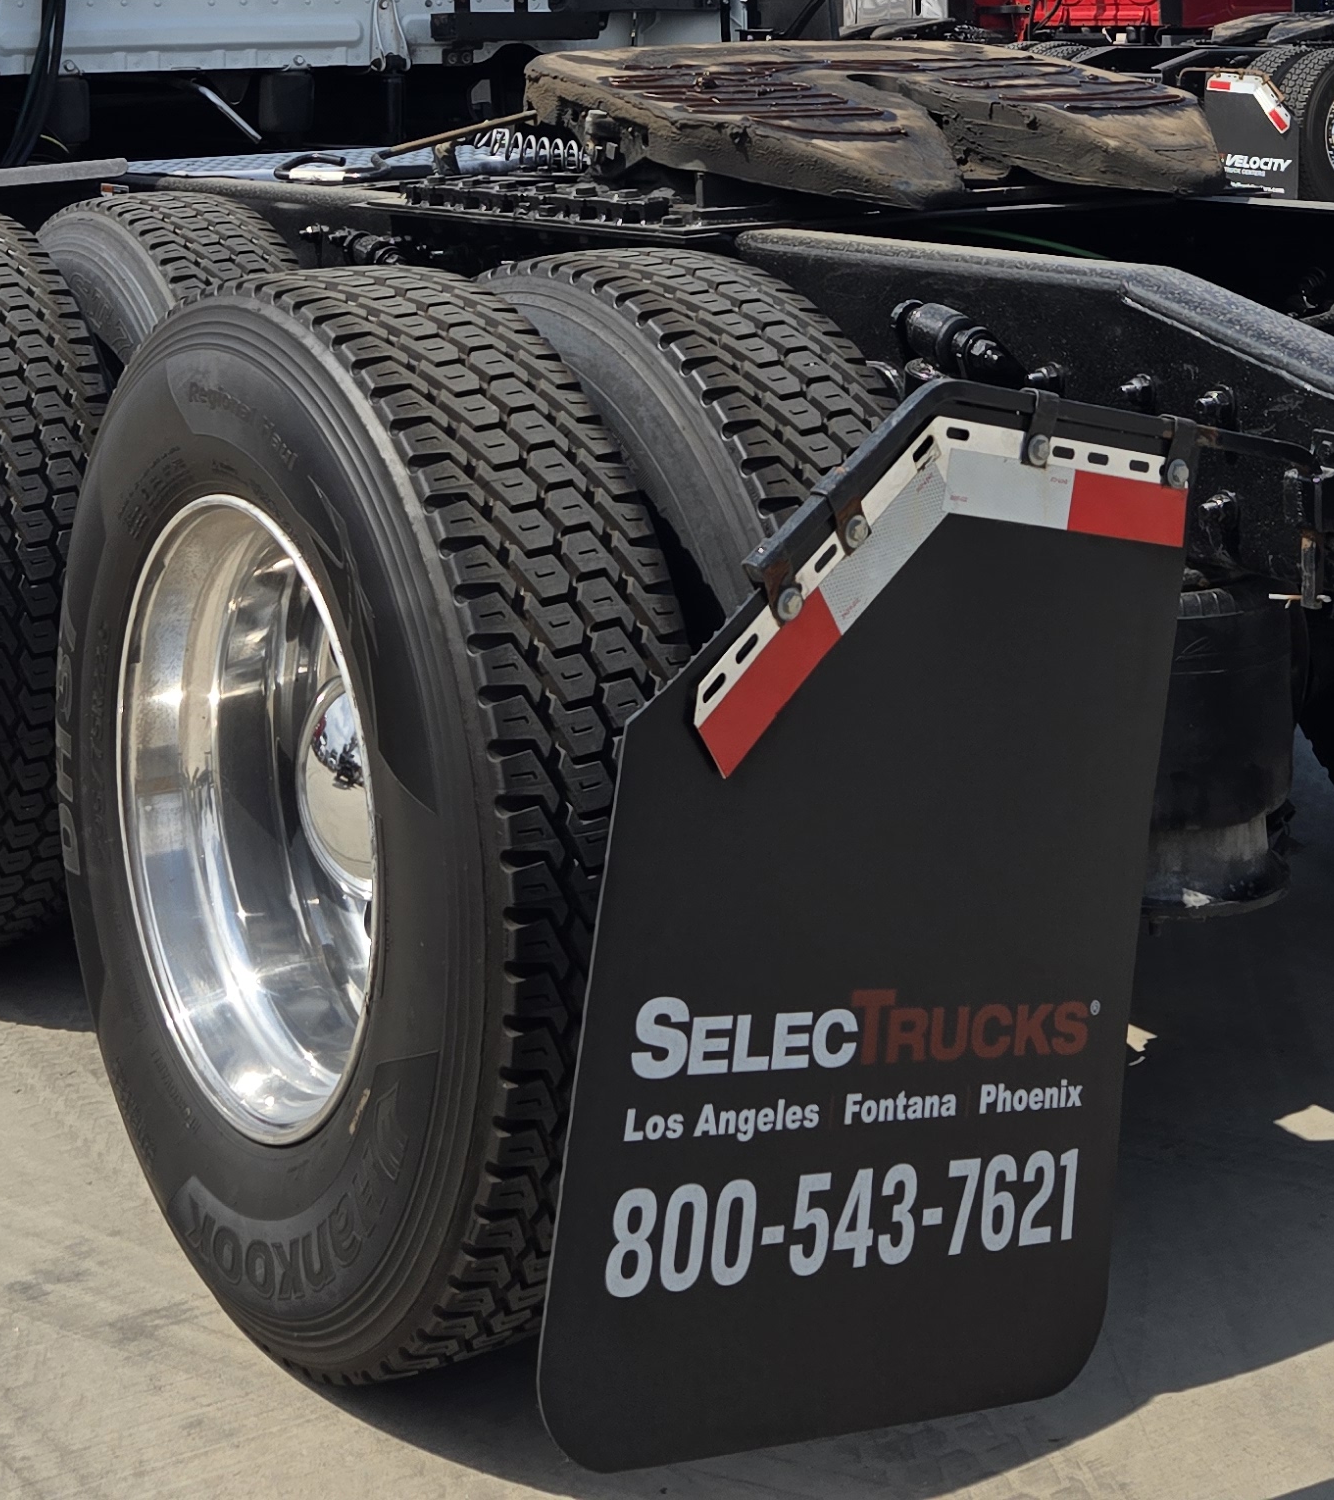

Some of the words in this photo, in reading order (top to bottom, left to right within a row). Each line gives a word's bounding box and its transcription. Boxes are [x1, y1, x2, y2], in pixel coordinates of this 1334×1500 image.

[1225, 153, 1292, 171] VELOCITY
[188, 381, 257, 424] Regional
[623, 1107, 684, 1142] Los
[692, 1098, 820, 1142] Angeles
[843, 1088, 957, 1127] Fontana
[978, 1079, 1083, 1115] Phoenix
[604, 1147, 1080, 1299] 800-543-7621
